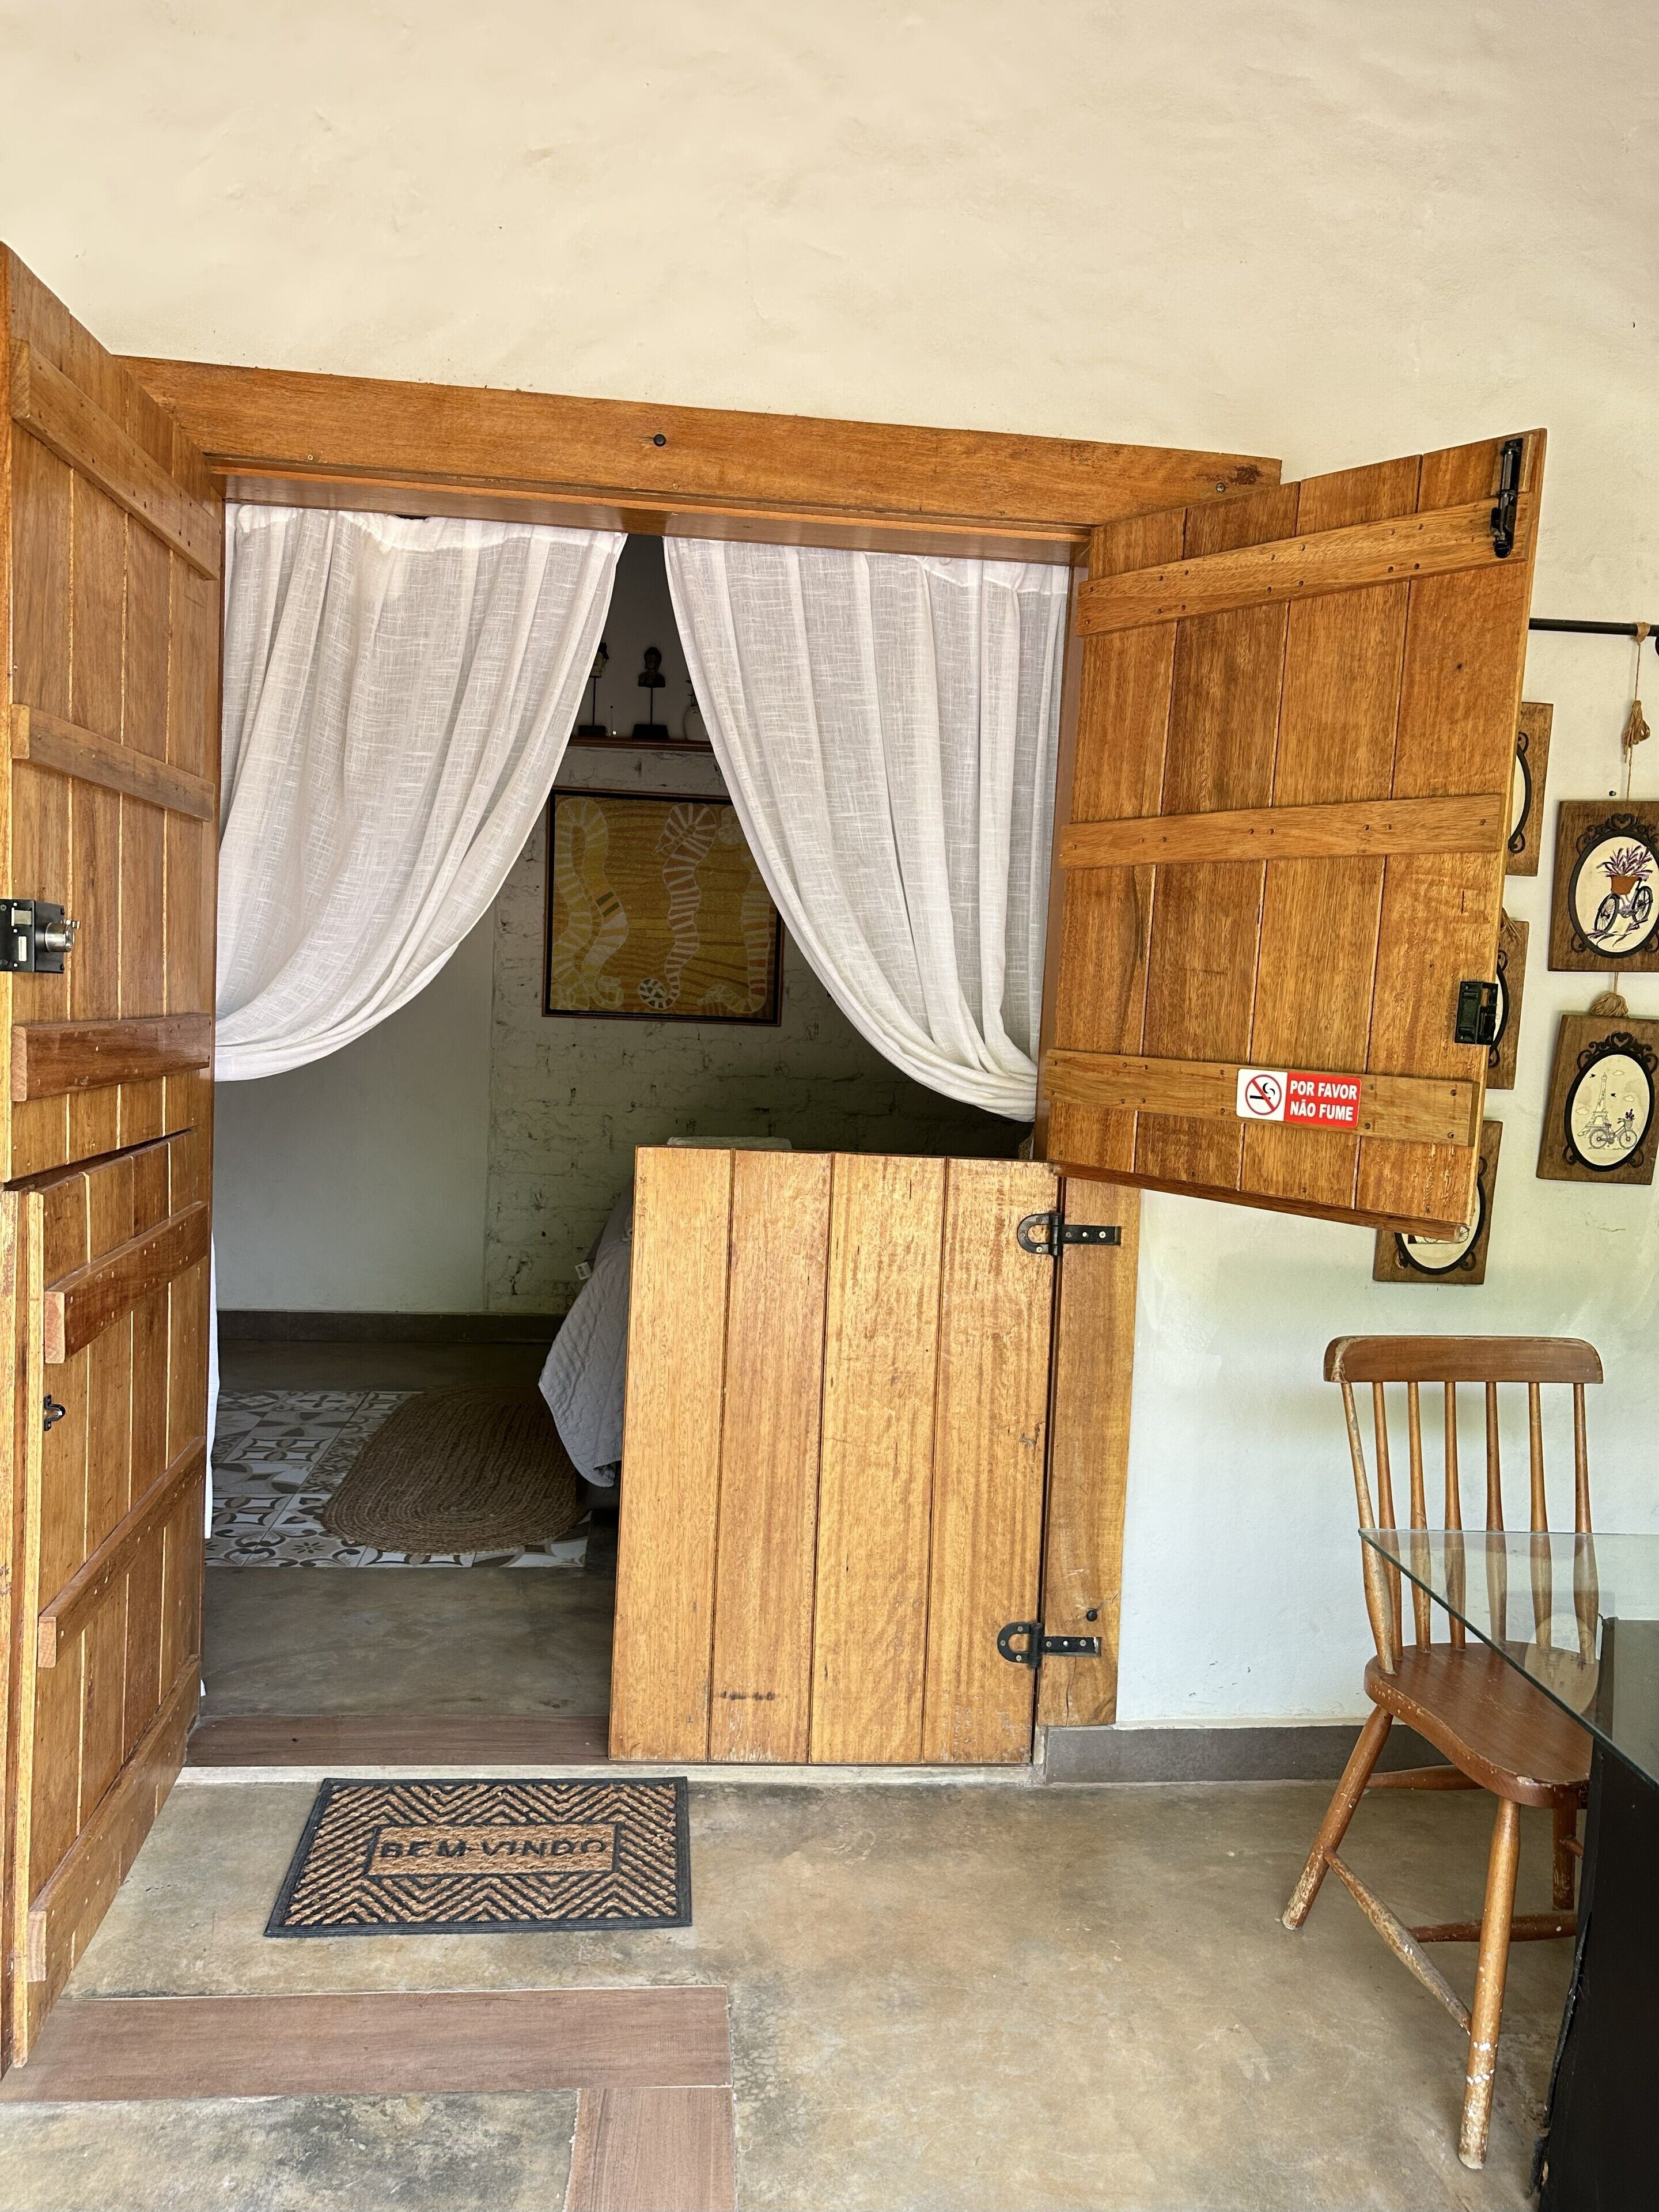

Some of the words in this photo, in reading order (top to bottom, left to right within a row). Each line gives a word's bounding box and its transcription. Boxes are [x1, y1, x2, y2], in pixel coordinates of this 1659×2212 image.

[1290, 1080, 1315, 1096] POR
[1318, 1082, 1357, 1100] FAVOR
[1290, 1099, 1316, 1117] NÃO
[1319, 1104, 1354, 1121] FUME
